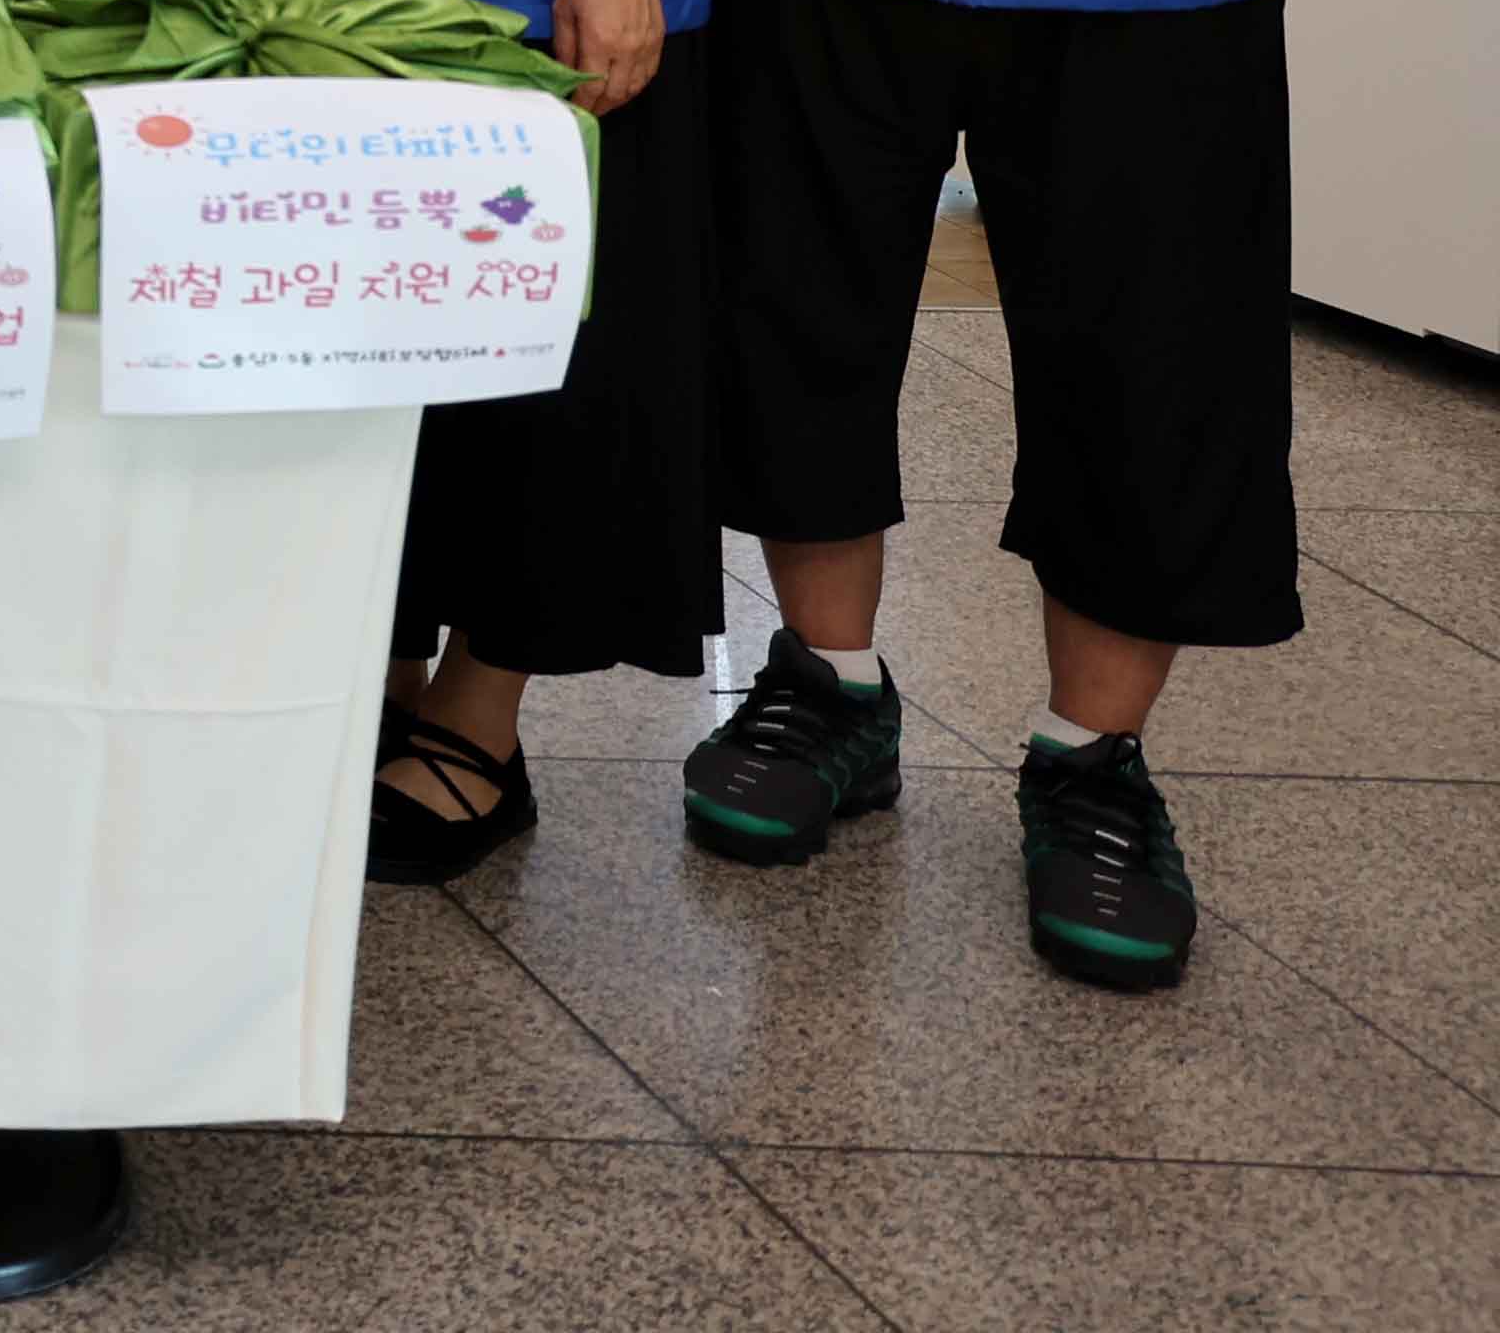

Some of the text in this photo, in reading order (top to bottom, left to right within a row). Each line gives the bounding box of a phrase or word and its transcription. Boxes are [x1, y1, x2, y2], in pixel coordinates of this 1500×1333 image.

[206, 123, 533, 167] 무더위 타파!!!
[200, 190, 352, 227] 비타민
[131, 260, 561, 311] 제철 과일 지원 사업
